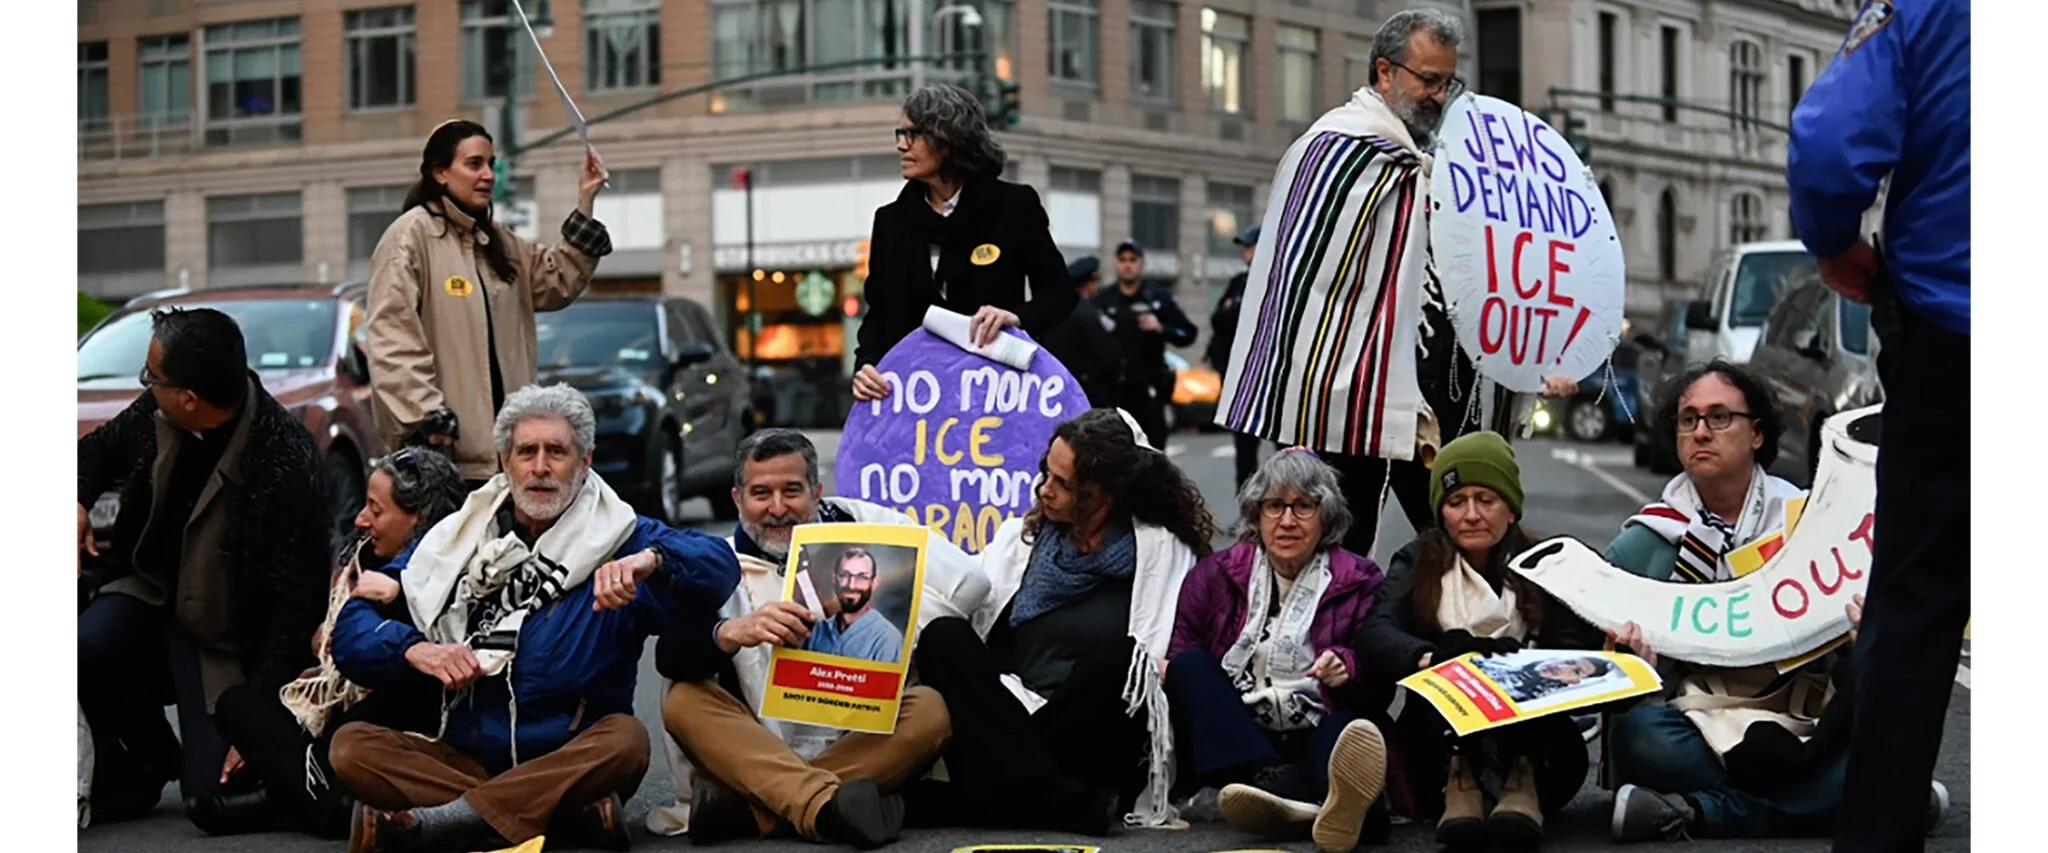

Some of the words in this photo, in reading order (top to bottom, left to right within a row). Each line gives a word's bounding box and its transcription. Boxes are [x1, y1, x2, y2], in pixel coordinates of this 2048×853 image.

[1464, 111, 1567, 183] JEWS
[1449, 162, 1598, 239] DEMAND:
[1484, 225, 1575, 306] ICE
[1479, 297, 1591, 366] OUT!
[871, 370, 941, 416] no
[960, 366, 1065, 417] more
[914, 416, 1005, 467] ICE
[860, 463, 920, 503] no
[1671, 592, 1752, 638] ICE
[809, 666, 832, 678] Alex
[834, 669, 867, 683] Pretti
